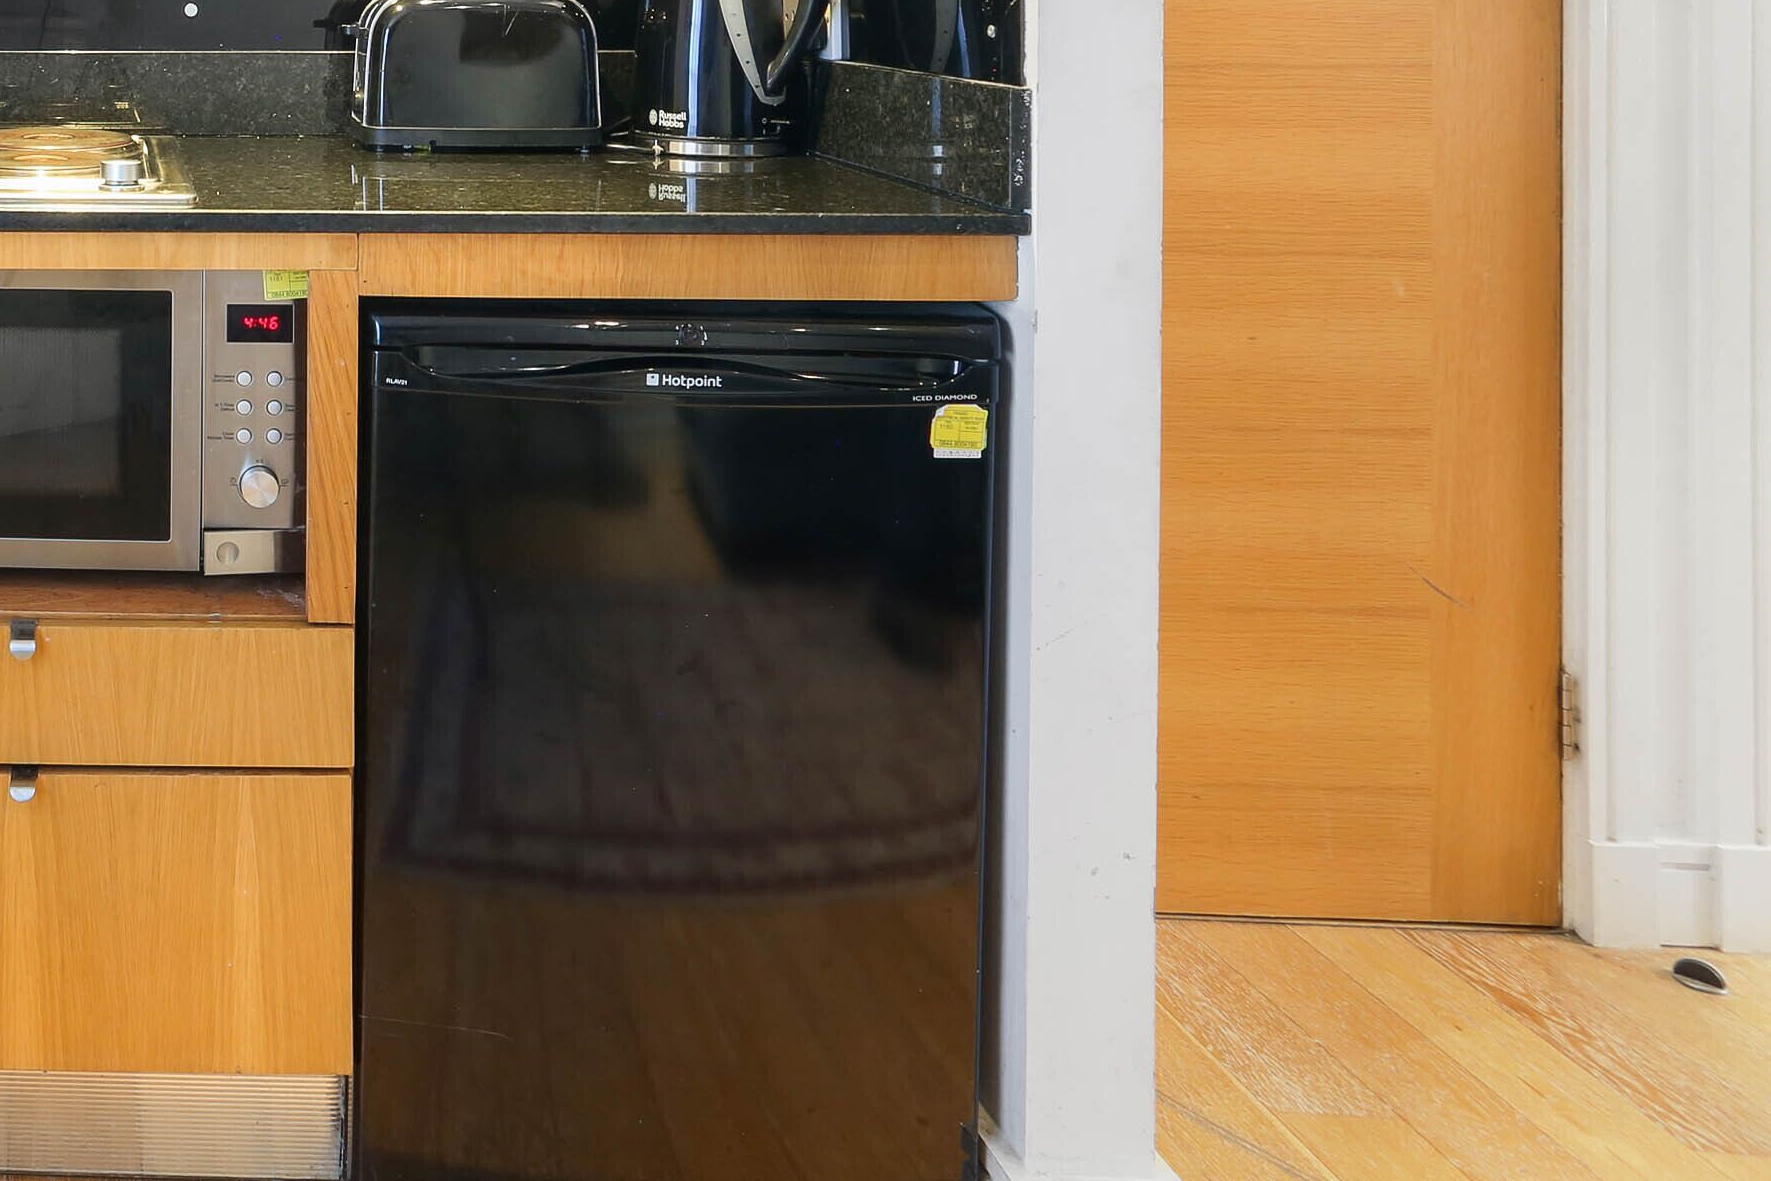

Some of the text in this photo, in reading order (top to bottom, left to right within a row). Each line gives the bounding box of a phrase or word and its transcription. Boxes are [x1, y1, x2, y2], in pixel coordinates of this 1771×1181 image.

[658, 109, 687, 121] Russell
[658, 117, 685, 129] Hobbs
[243, 316, 280, 331] 4:46
[662, 373, 723, 389] Hotpoint
[934, 394, 978, 402] DIAMOND
